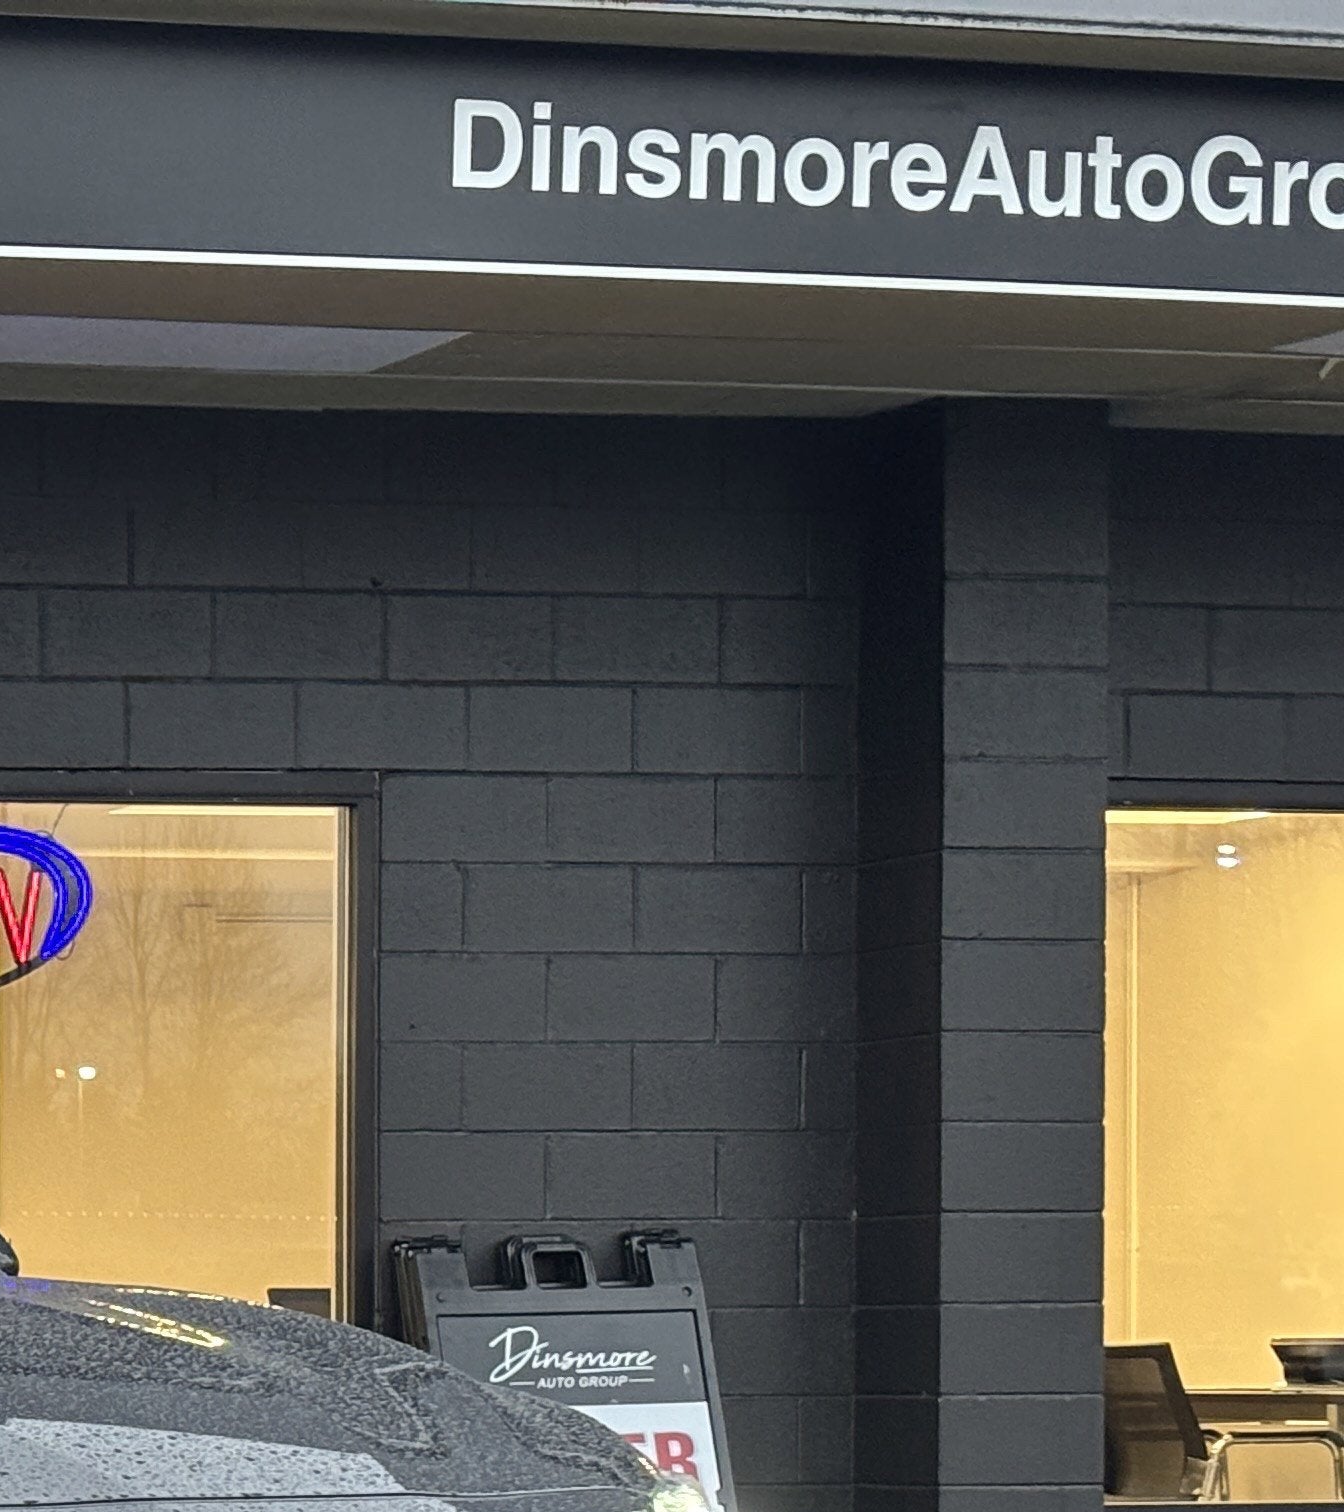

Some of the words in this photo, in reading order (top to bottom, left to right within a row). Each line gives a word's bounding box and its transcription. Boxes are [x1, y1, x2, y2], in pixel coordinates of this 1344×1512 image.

[488, 1325, 657, 1384] Dinsmore
[536, 1376, 576, 1389] AUTO
[578, 1375, 629, 1388] GROUP
